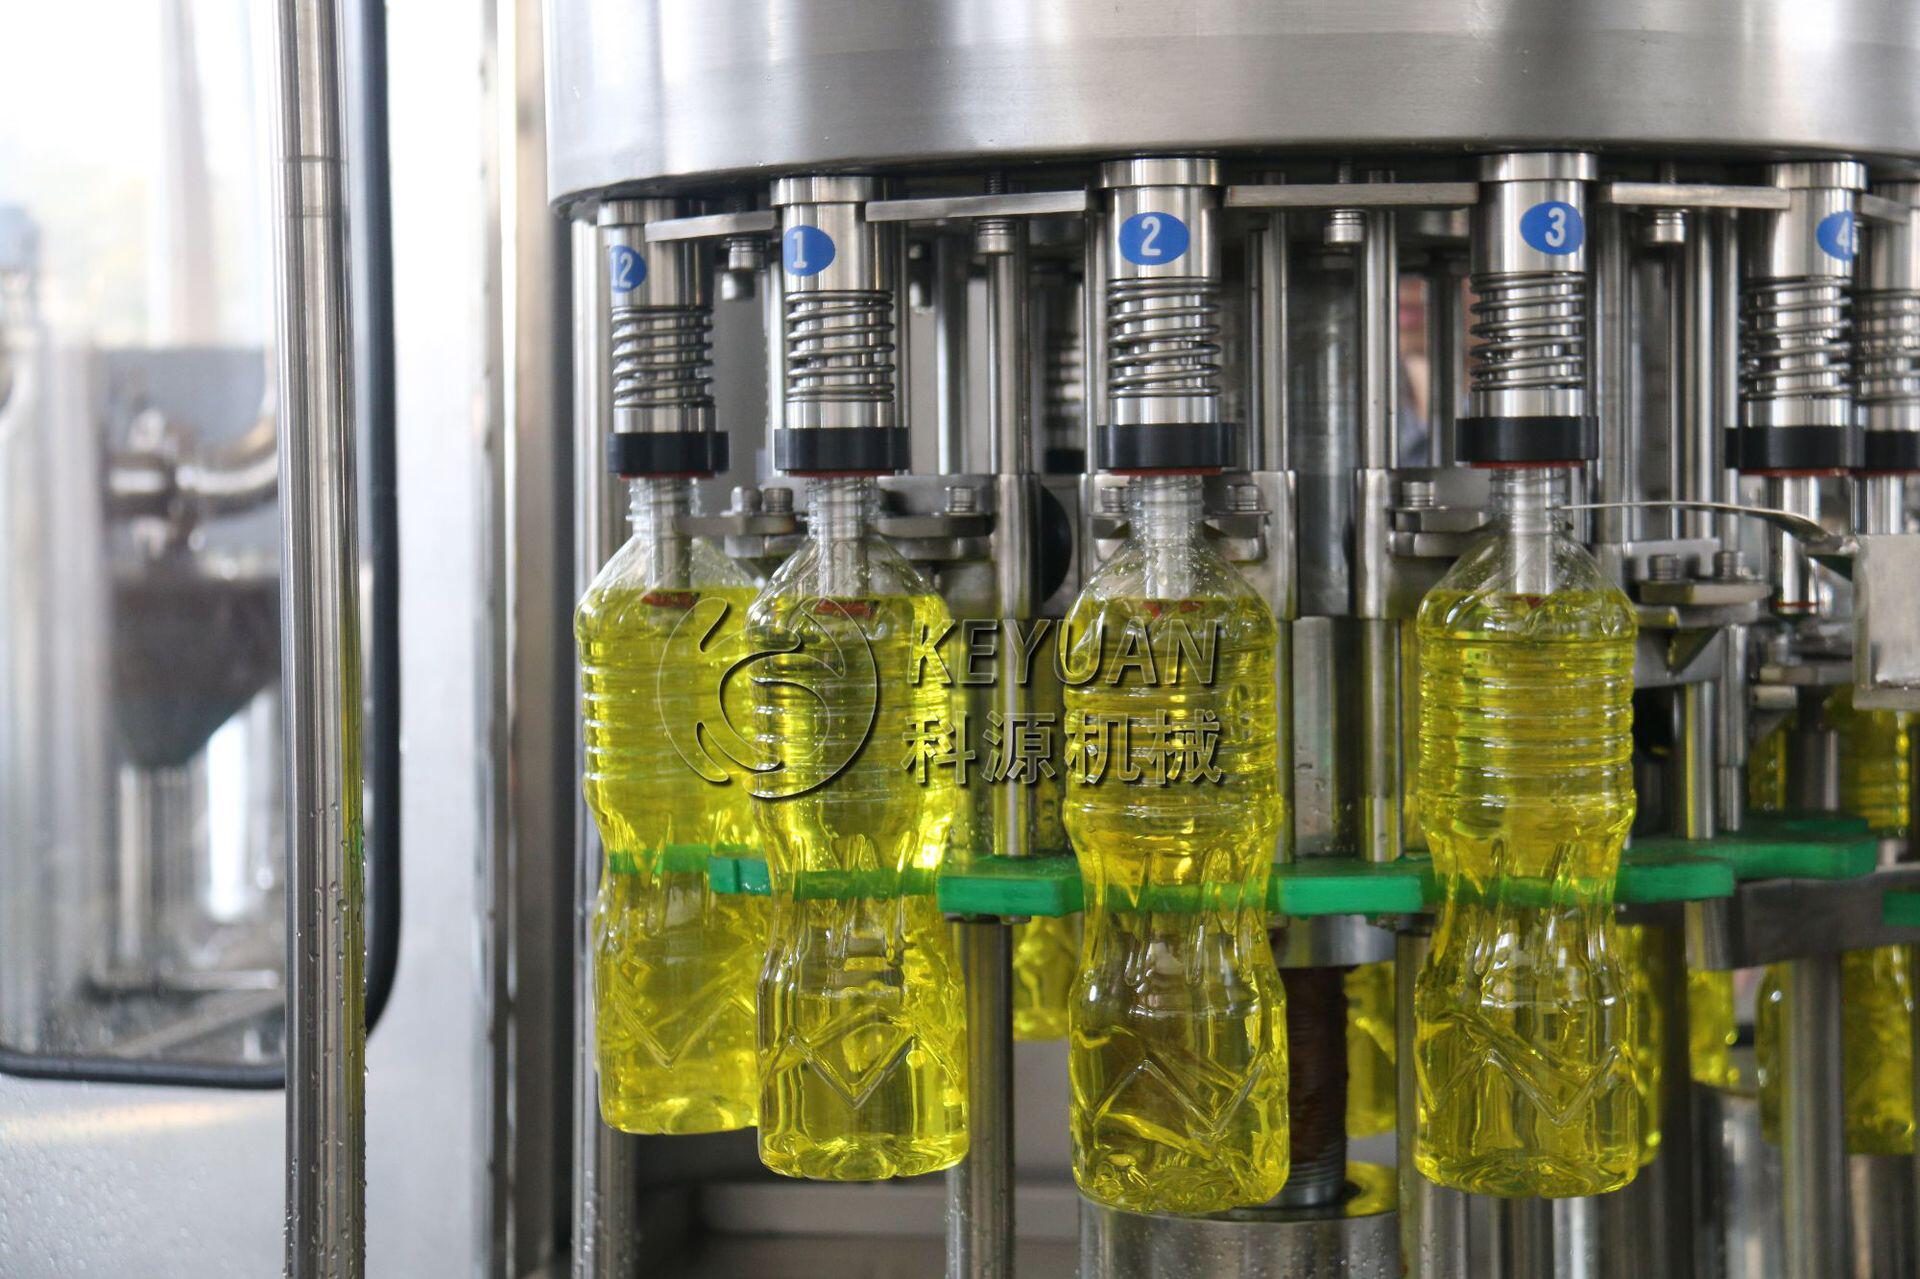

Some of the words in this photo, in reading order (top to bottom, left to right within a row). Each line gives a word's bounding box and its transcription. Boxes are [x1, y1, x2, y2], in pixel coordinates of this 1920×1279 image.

[1141, 216, 1161, 256] 2
[1545, 207, 1566, 248] 3
[1836, 216, 1851, 255] 4
[792, 231, 807, 269] 1
